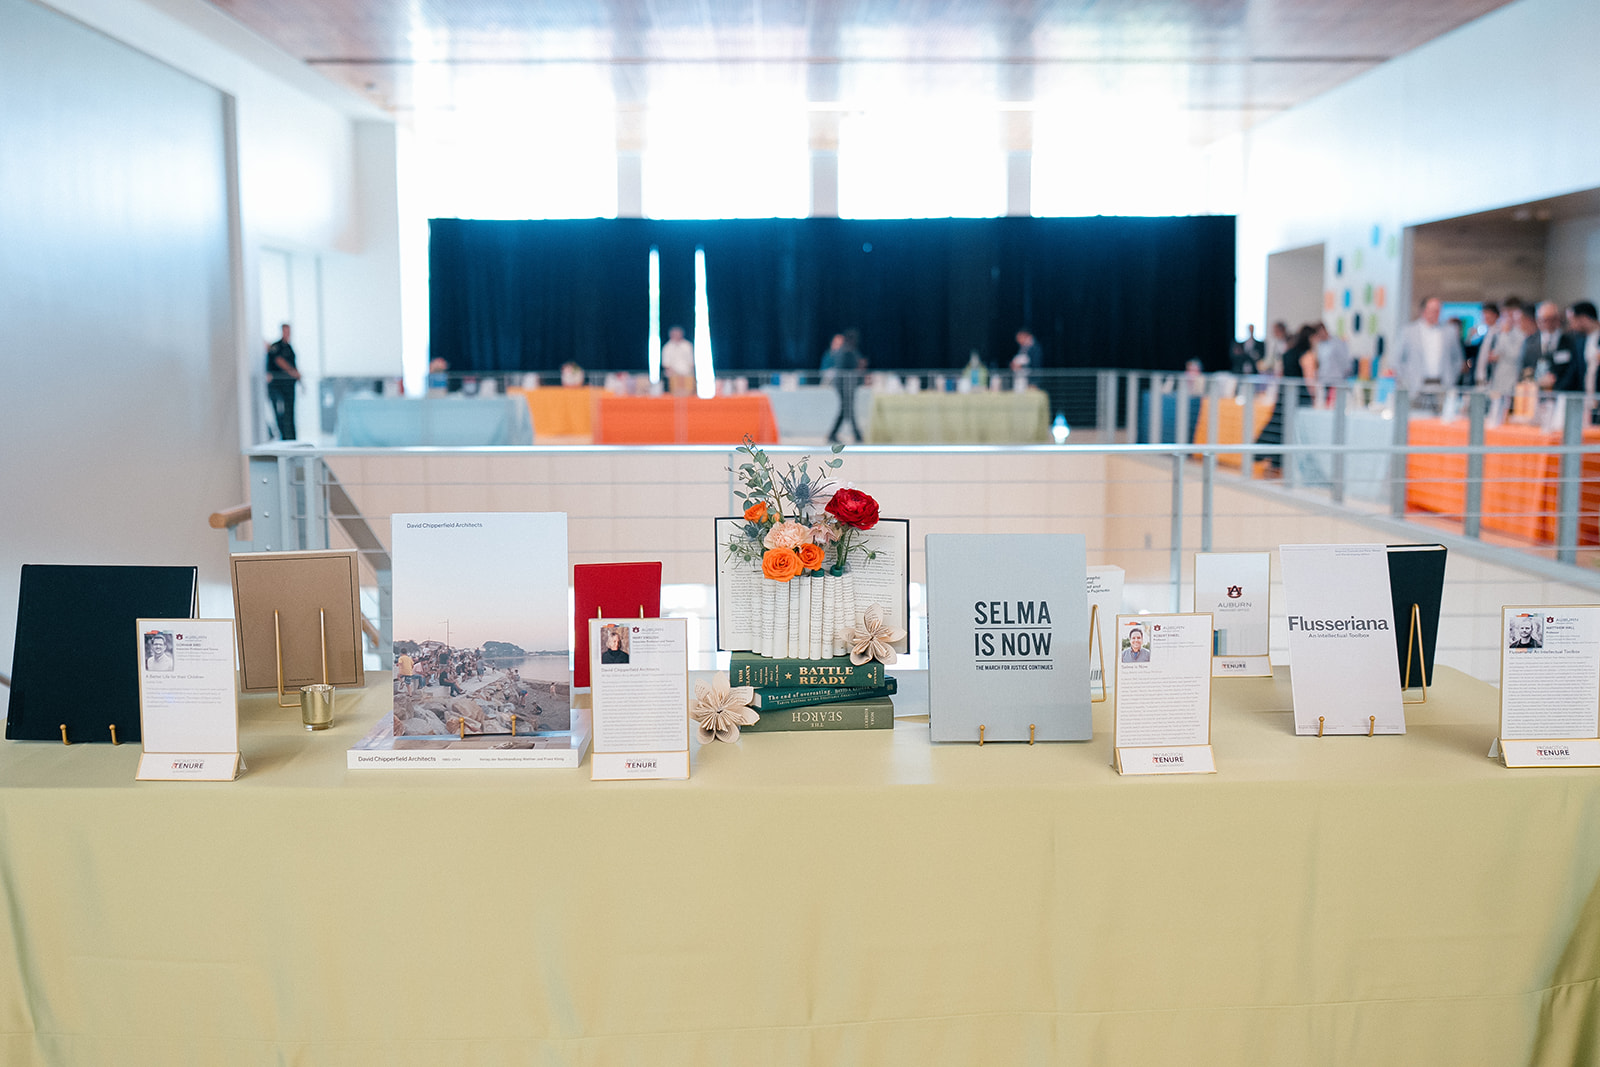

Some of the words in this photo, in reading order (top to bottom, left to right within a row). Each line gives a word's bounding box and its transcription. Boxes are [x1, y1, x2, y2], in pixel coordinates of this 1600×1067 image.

[974, 601, 1051, 624] SELMA
[1288, 616, 1388, 631] Flusseriana
[975, 633, 995, 656] IS
[1002, 632, 1052, 656] NOW
[799, 666, 853, 675] BATTLE
[799, 676, 847, 685] READY
[792, 711, 842, 722] SEARCH
